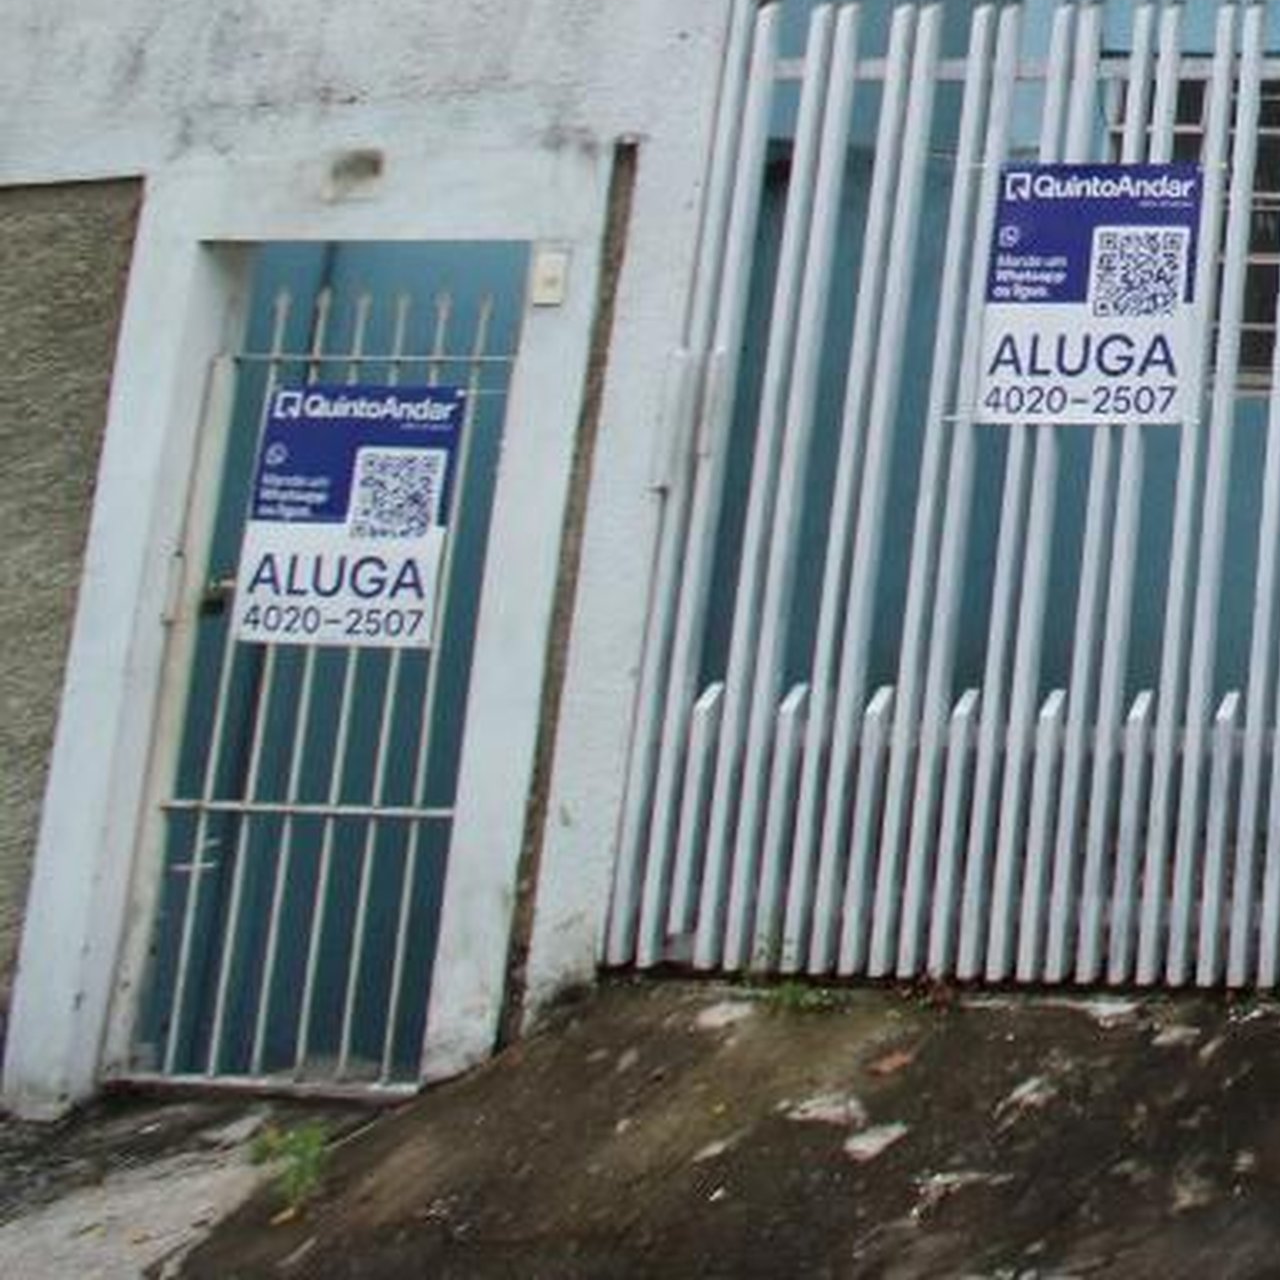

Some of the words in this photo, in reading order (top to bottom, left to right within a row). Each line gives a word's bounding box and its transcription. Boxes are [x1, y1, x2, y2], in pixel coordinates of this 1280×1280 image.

[1032, 174, 1195, 200] QuintoAndar
[987, 332, 1178, 378] ALUGA
[303, 394, 460, 421] QuintoAndar
[984, 385, 1178, 414] 4020-2507
[248, 552, 425, 599] ALUGA
[242, 605, 425, 637] 4020-2507
